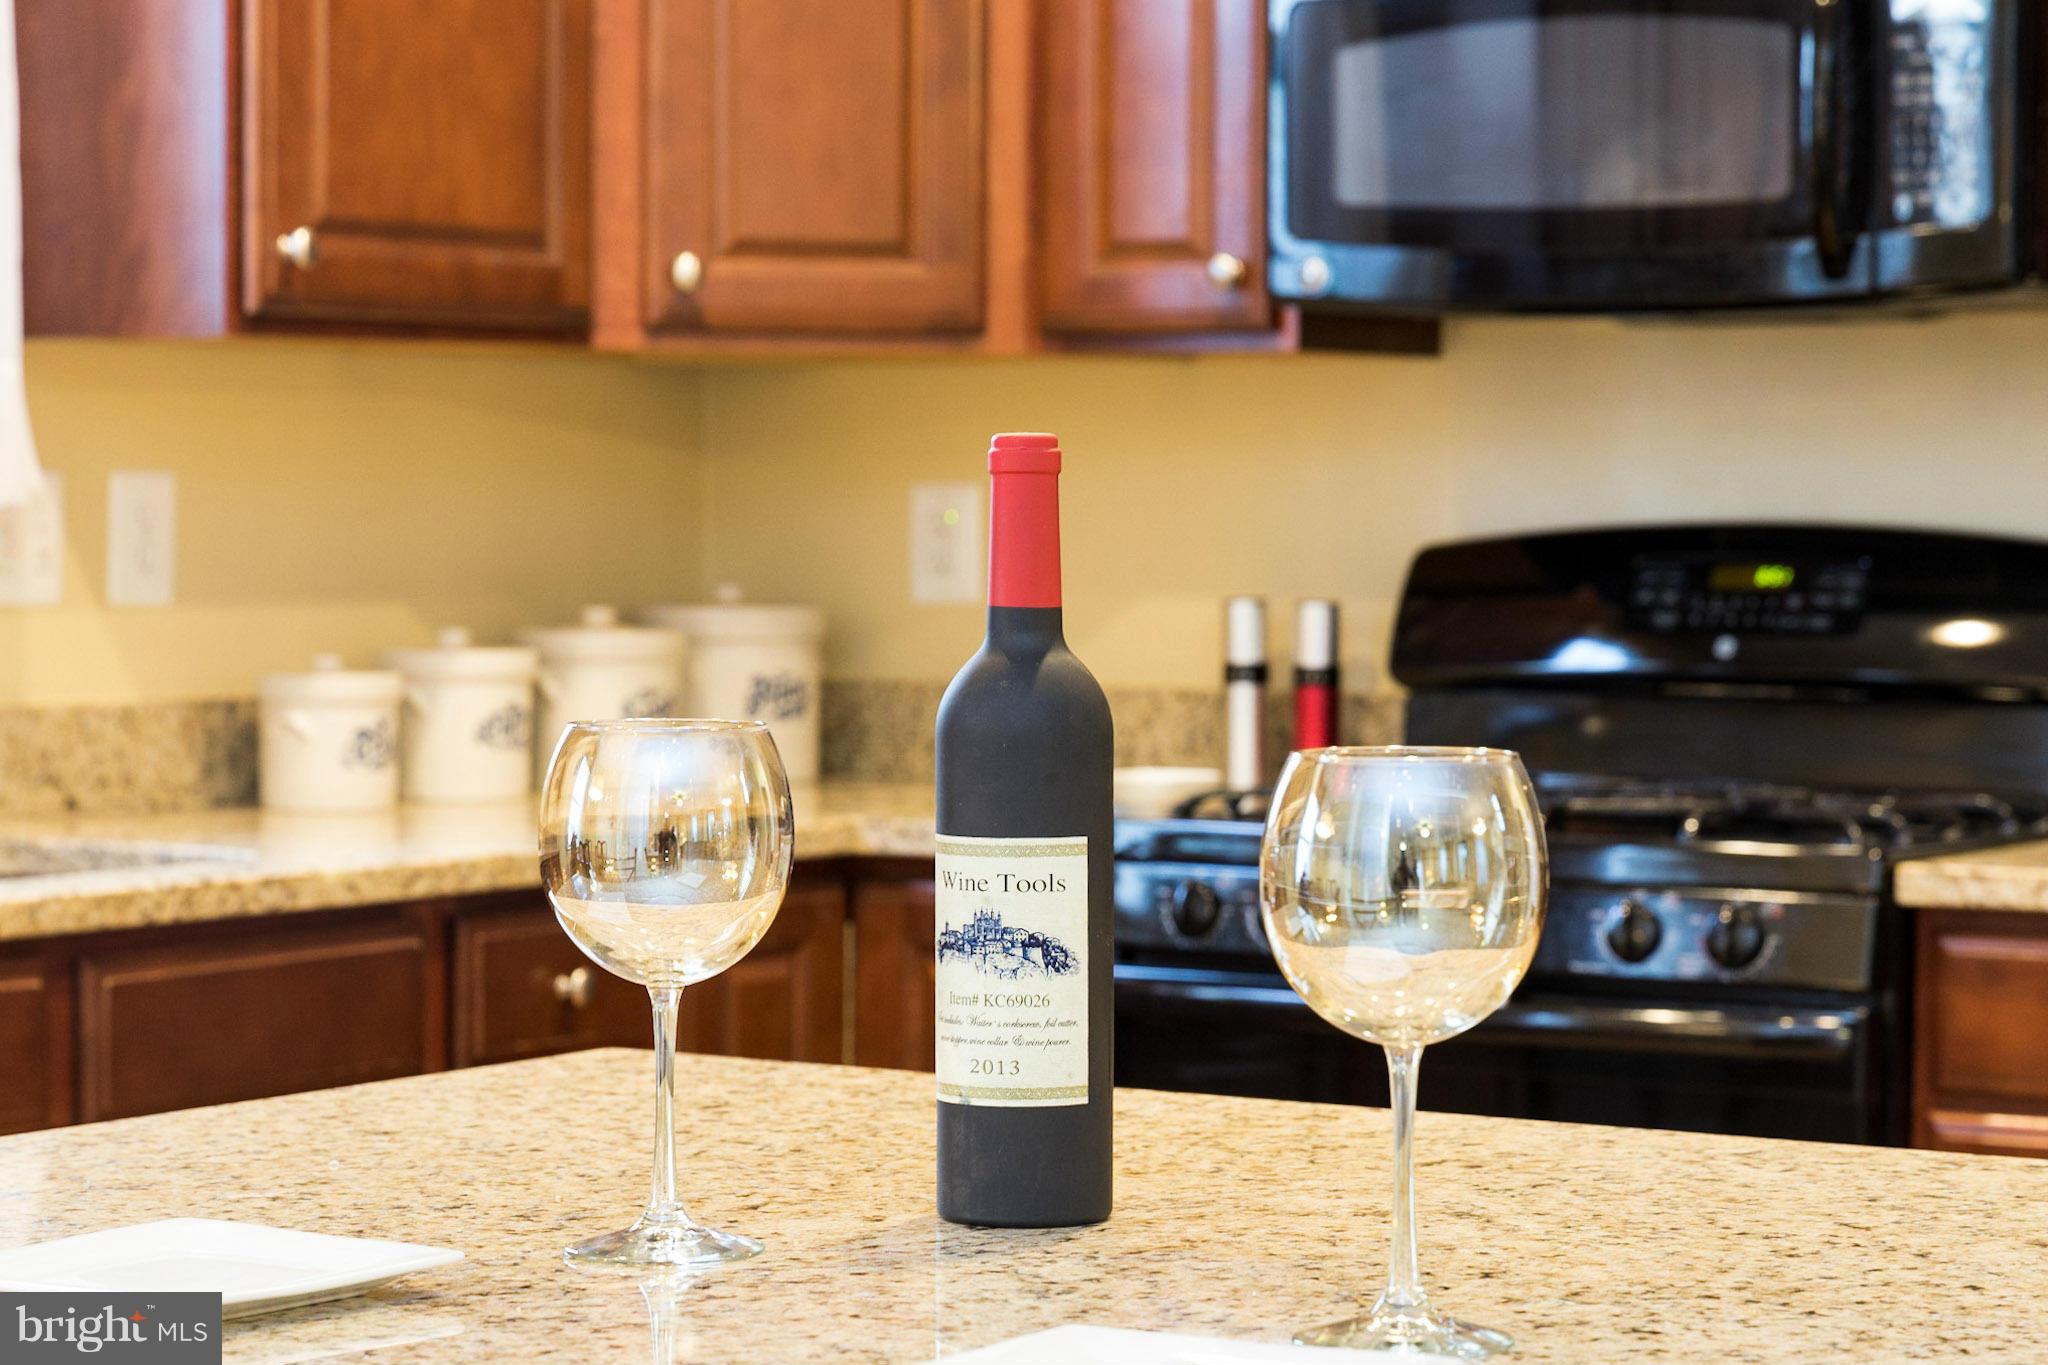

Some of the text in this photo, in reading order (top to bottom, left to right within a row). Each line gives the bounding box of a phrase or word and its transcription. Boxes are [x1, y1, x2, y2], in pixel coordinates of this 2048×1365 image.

[942, 870, 1067, 893] Wine Tools
[949, 991, 1050, 1008] Item# KC69026
[1025, 1038, 1045, 1047] wine
[969, 1058, 1020, 1076] 2013
